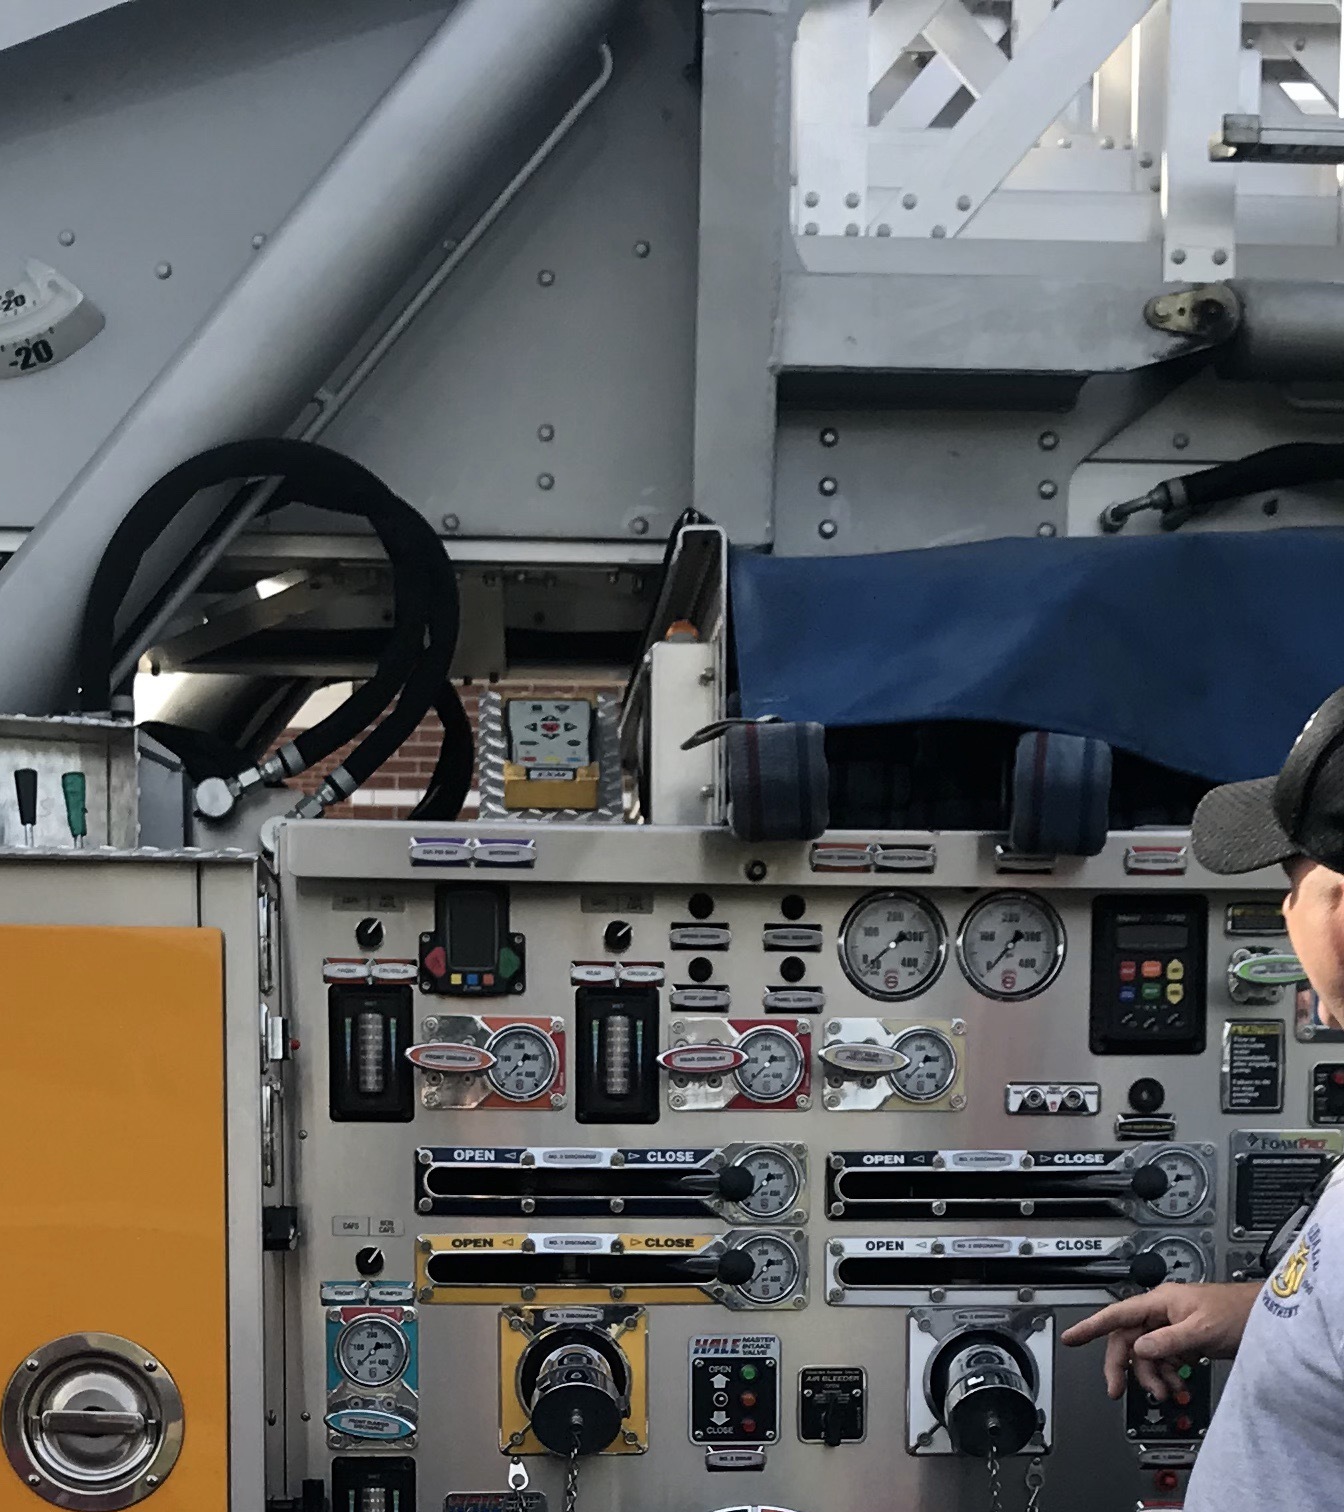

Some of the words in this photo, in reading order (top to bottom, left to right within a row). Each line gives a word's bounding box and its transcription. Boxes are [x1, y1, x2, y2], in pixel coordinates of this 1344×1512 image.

[9, 338, 54, 371] -20
[453, 1149, 496, 1161] OPEN
[646, 1150, 695, 1162] CLOSE
[863, 1154, 905, 1165] OPEN
[1053, 1154, 1105, 1164] CLOSE
[451, 1237, 494, 1248] OPEN
[644, 1237, 695, 1248] CLOSE
[865, 1240, 905, 1251] OPEN
[1055, 1240, 1103, 1251] CLOSE
[693, 1338, 742, 1355] HALE
[708, 1365, 732, 1374] OPEN
[706, 1426, 734, 1435] CLOSE
